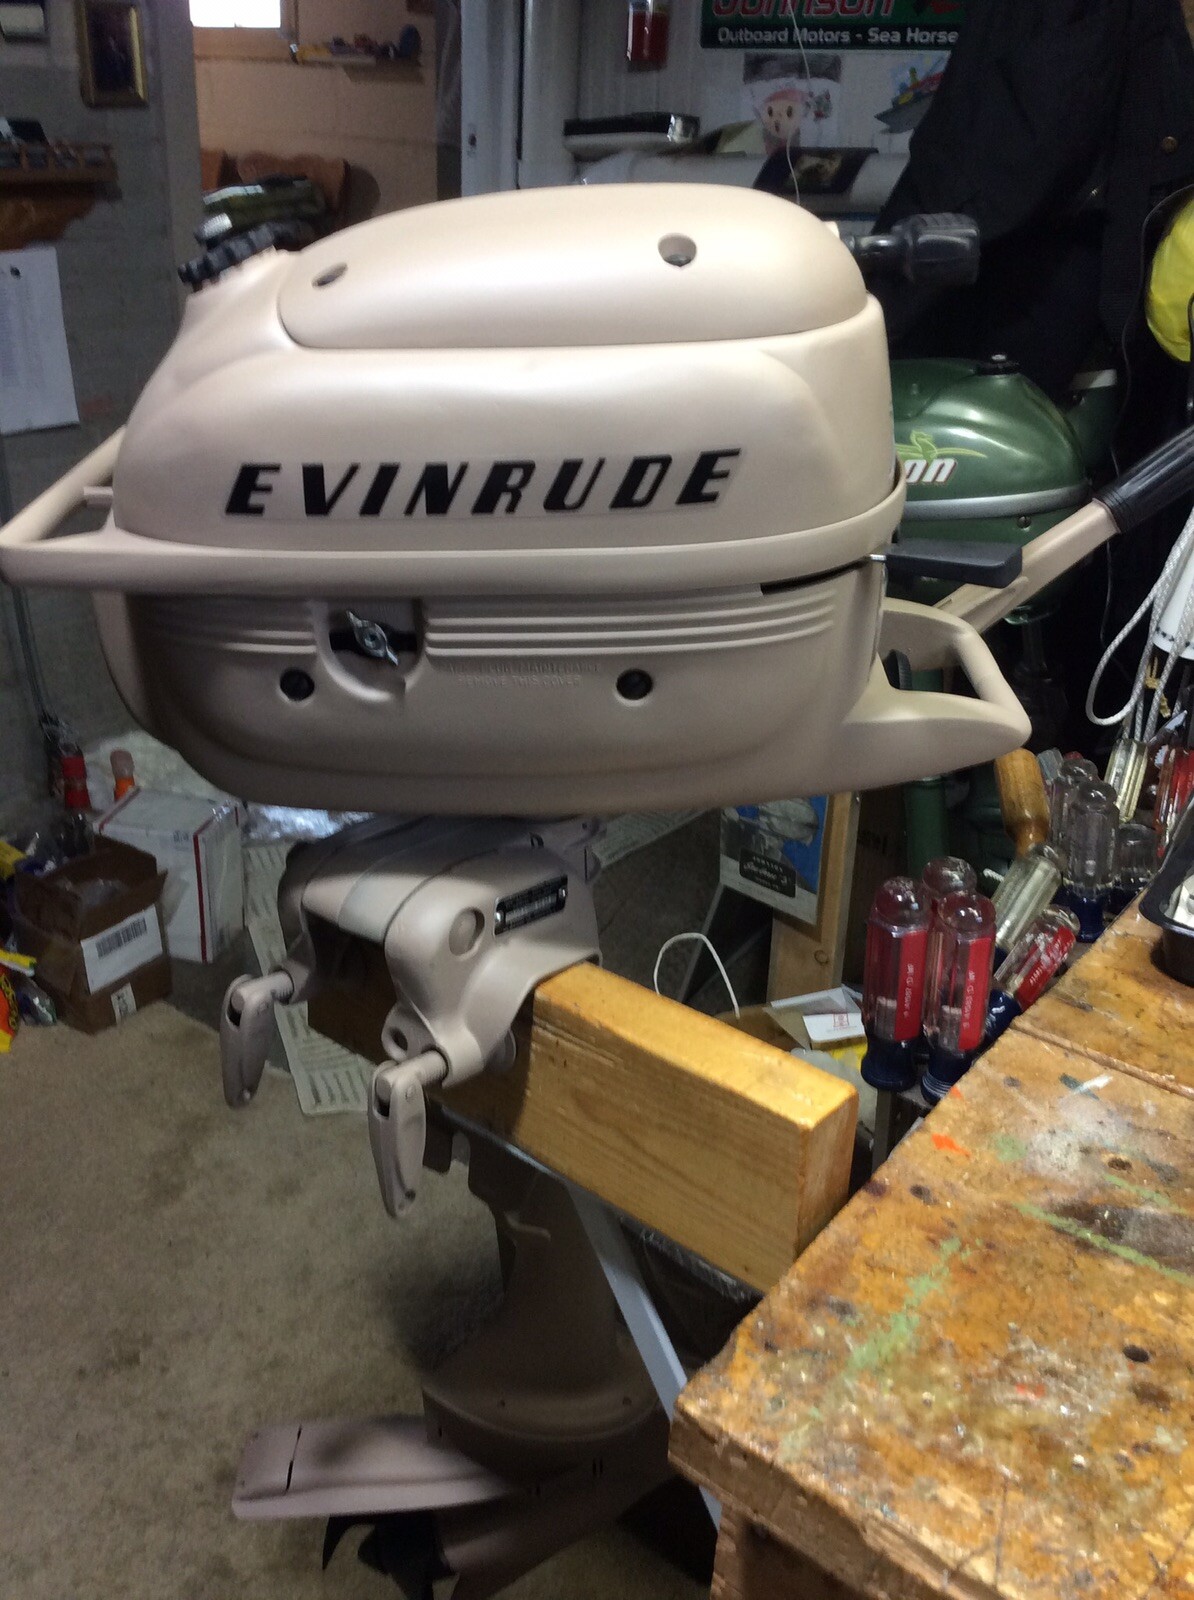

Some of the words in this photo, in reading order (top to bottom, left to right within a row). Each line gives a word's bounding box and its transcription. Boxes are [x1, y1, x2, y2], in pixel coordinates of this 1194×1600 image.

[717, 26, 789, 43] Outboard
[793, 26, 850, 43] Motors
[867, 26, 900, 43] Sea
[906, 26, 959, 43] Horse
[224, 447, 741, 516] EVINRUDE
